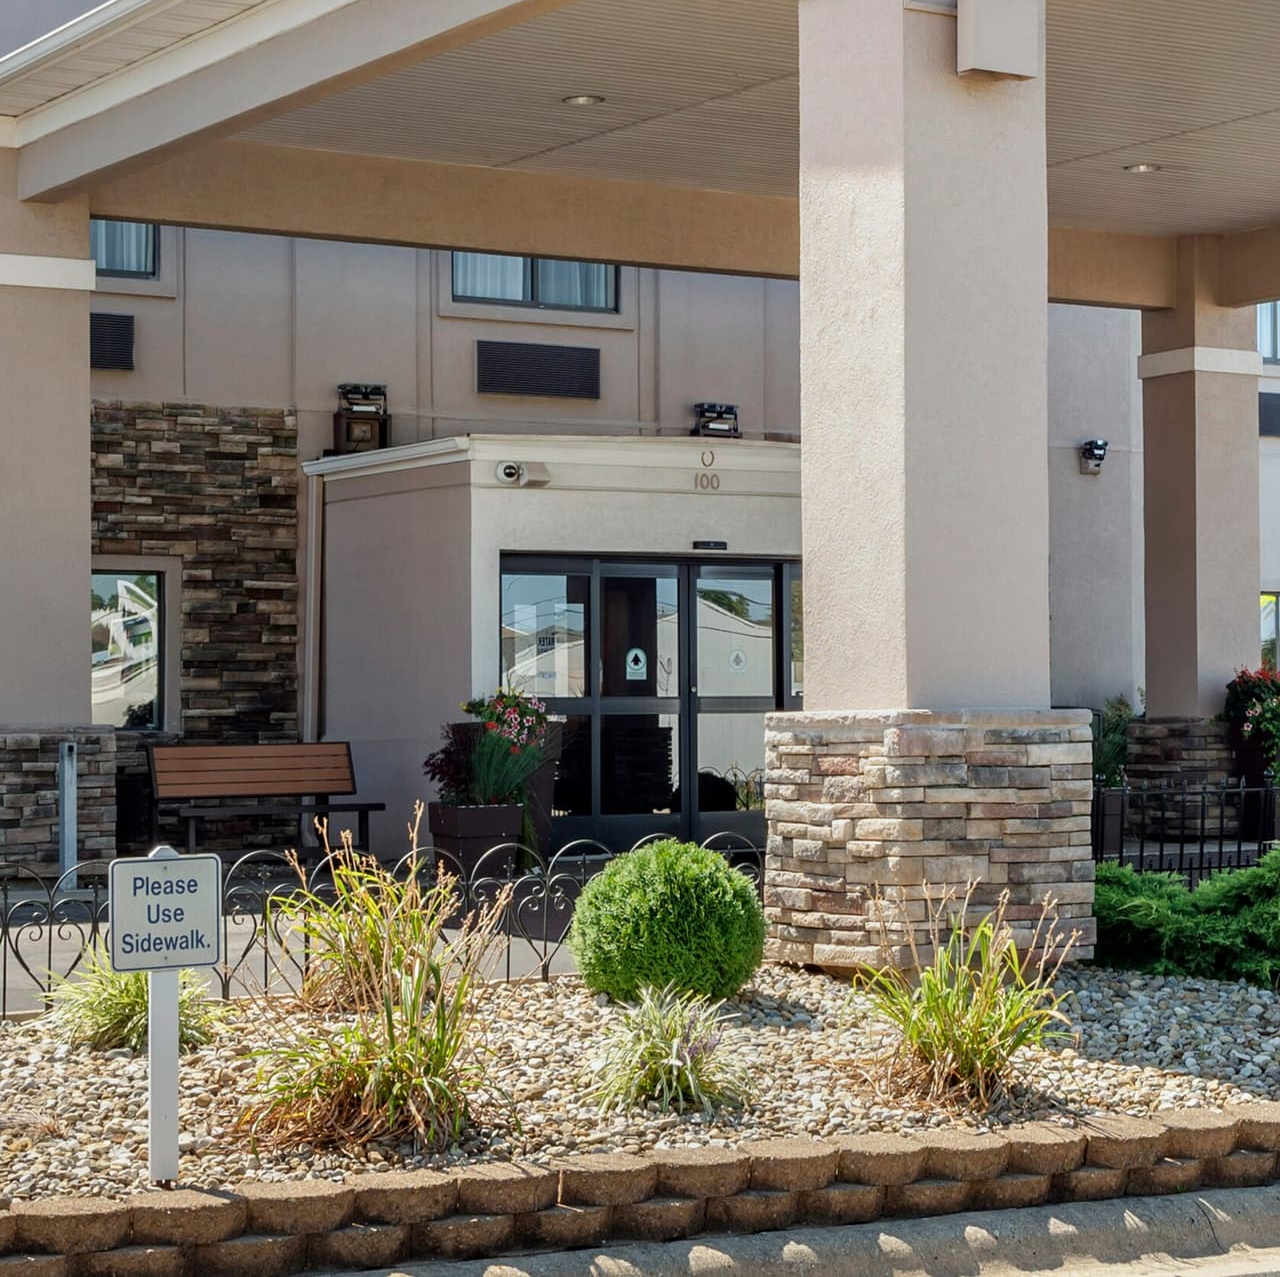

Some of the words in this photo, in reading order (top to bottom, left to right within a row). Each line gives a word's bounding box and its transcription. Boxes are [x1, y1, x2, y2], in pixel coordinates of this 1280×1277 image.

[694, 472, 720, 491] 100
[133, 876, 198, 897] Please
[147, 903, 184, 924] Use
[121, 929, 211, 954] Sidewalk.
